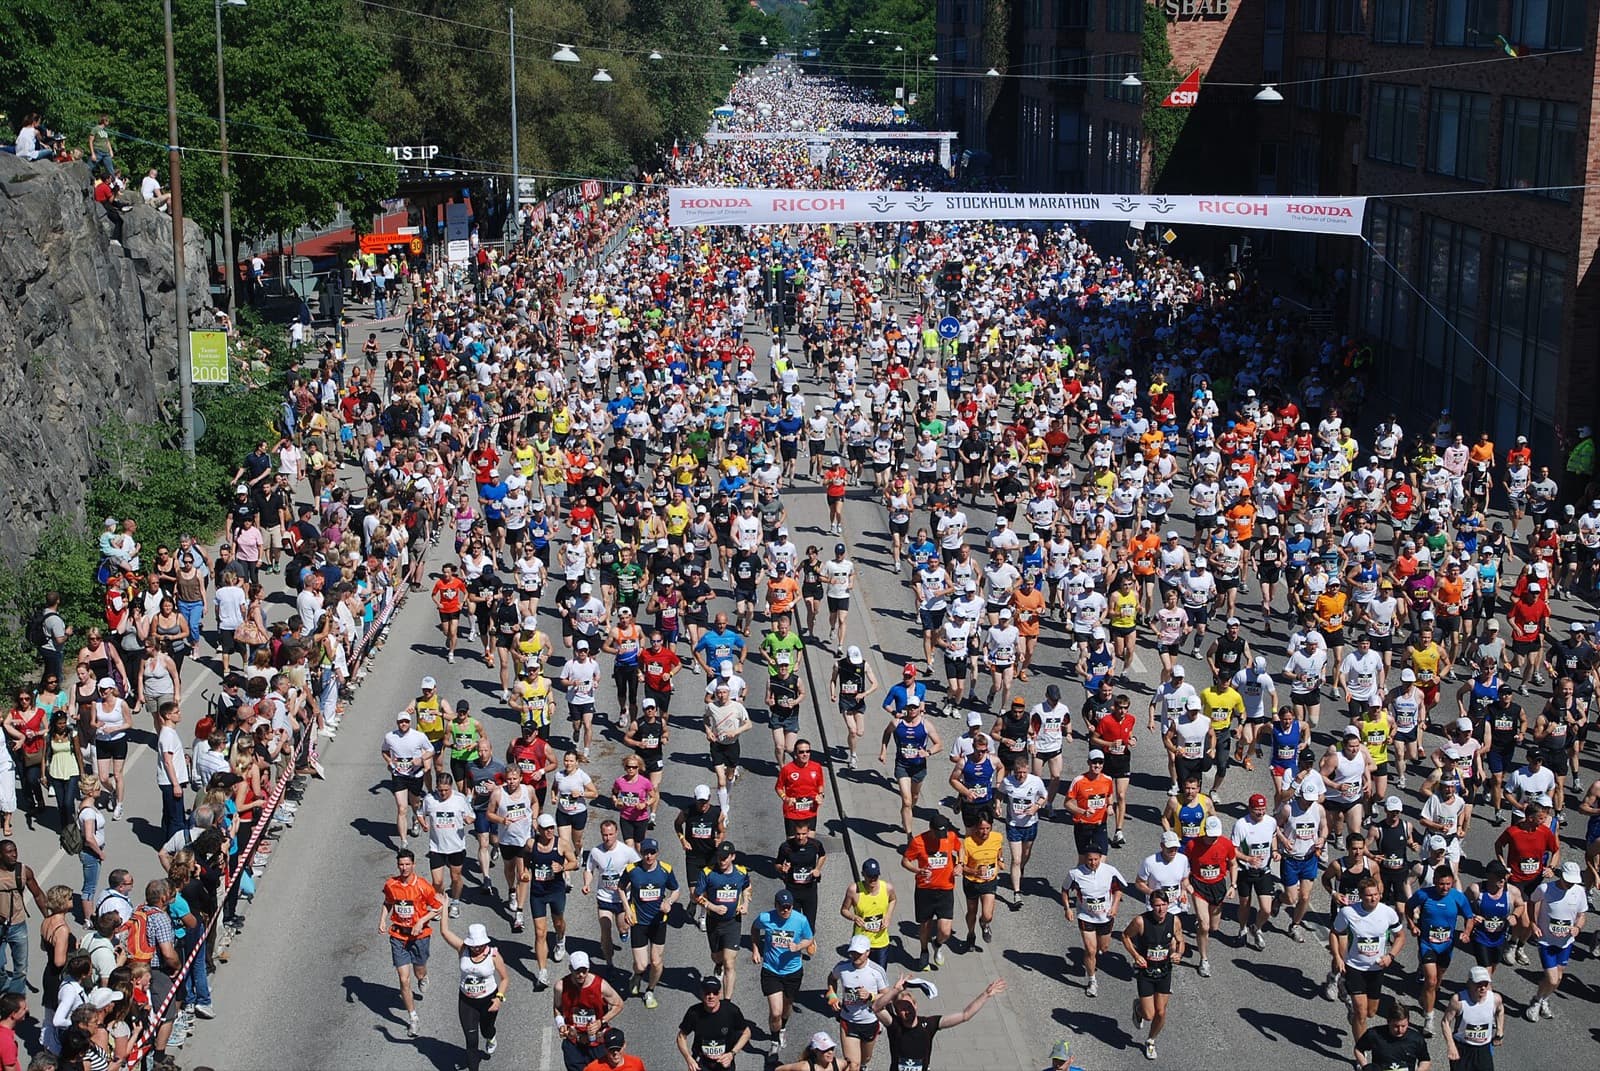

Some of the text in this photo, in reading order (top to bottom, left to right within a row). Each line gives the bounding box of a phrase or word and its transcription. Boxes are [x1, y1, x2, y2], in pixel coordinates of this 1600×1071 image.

[1166, 0, 1230, 14] SBAB
[1171, 91, 1198, 104] csn
[680, 198, 845, 212] HONDA RICOH
[946, 196, 1100, 209] STOCKHOLM MARATHON
[1199, 200, 1268, 217] RICOH
[1287, 203, 1353, 218] HONDA
[192, 366, 228, 381] 2009
